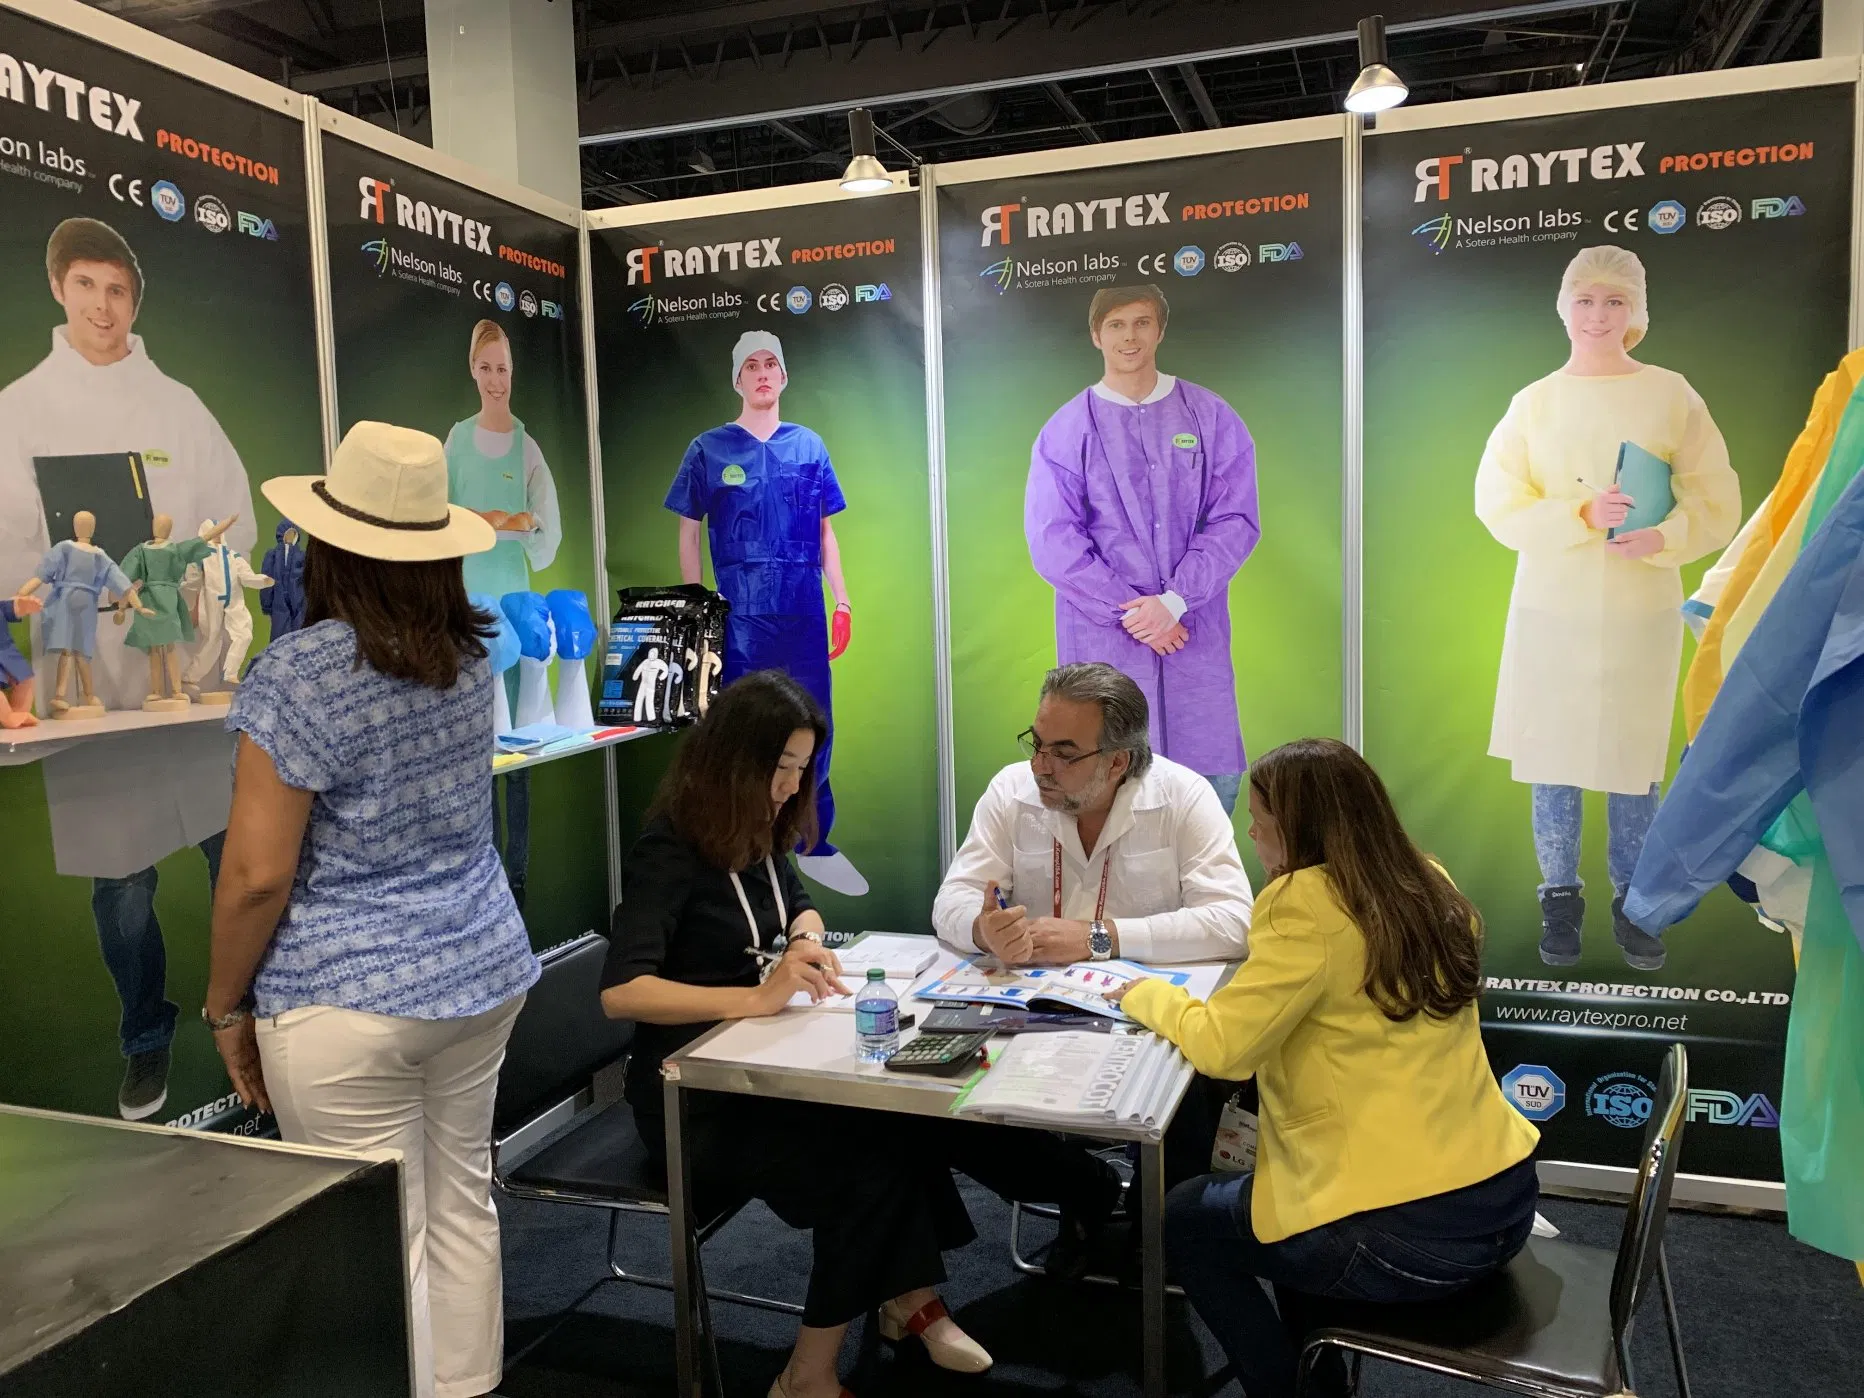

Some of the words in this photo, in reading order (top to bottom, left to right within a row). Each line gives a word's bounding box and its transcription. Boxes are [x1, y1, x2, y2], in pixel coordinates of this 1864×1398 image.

[39, 140, 87, 176] labs
[156, 129, 279, 186] PROTECTION
[1471, 141, 1646, 193] RAYTEX
[1659, 142, 1814, 174] PROTECTION
[33, 170, 83, 194] company
[108, 173, 144, 207] CE
[197, 206, 228, 228] ISO
[1027, 191, 1171, 238] RAYTEX
[1182, 192, 1309, 221] PROTECTION
[1701, 208, 1738, 225] ISO
[1751, 195, 1807, 220] FDA
[237, 210, 279, 241] FDA
[1456, 214, 1531, 236] Nelson
[1538, 208, 1582, 228] labs
[1603, 208, 1639, 233] CE
[395, 193, 493, 256] RAYTEX
[498, 244, 566, 279] PROTECTION
[1455, 239, 1463, 248] A
[1466, 237, 1496, 248] Sotera
[1499, 233, 1530, 245] Health
[1532, 230, 1578, 242] company
[663, 237, 783, 278] RAYTEX
[791, 239, 895, 264] PROTECTION
[1137, 252, 1167, 275] CE
[1217, 253, 1248, 268] ISO
[1259, 241, 1304, 263] FDA
[391, 247, 436, 276] Nelson
[439, 260, 463, 284] labs
[1016, 258, 1078, 277] Nelson
[1083, 252, 1120, 271] labs
[472, 279, 492, 302] CE
[1016, 281, 1022, 289] A
[1024, 279, 1050, 289] Sotera
[1051, 275, 1078, 286] Health
[1079, 272, 1117, 284] company
[657, 296, 708, 314] Nelson
[711, 291, 742, 308] labs
[756, 292, 781, 312] CE
[822, 293, 846, 307] ISO
[855, 283, 892, 303] FDA
[521, 299, 536, 313] ISO
[541, 299, 564, 320] FDA
[657, 316, 663, 324] A
[664, 314, 685, 324] Sotera
[686, 310, 708, 321] Health
[708, 309, 741, 319] company
[1485, 976, 1564, 993] RAYTEX
[1564, 981, 1701, 1001] PROTECTION
[1496, 1006, 1689, 1031] www.raytexpro.net
[1517, 1083, 1550, 1098] TÜV
[1593, 1093, 1654, 1119] ISO
[1685, 1088, 1780, 1129] FDA
